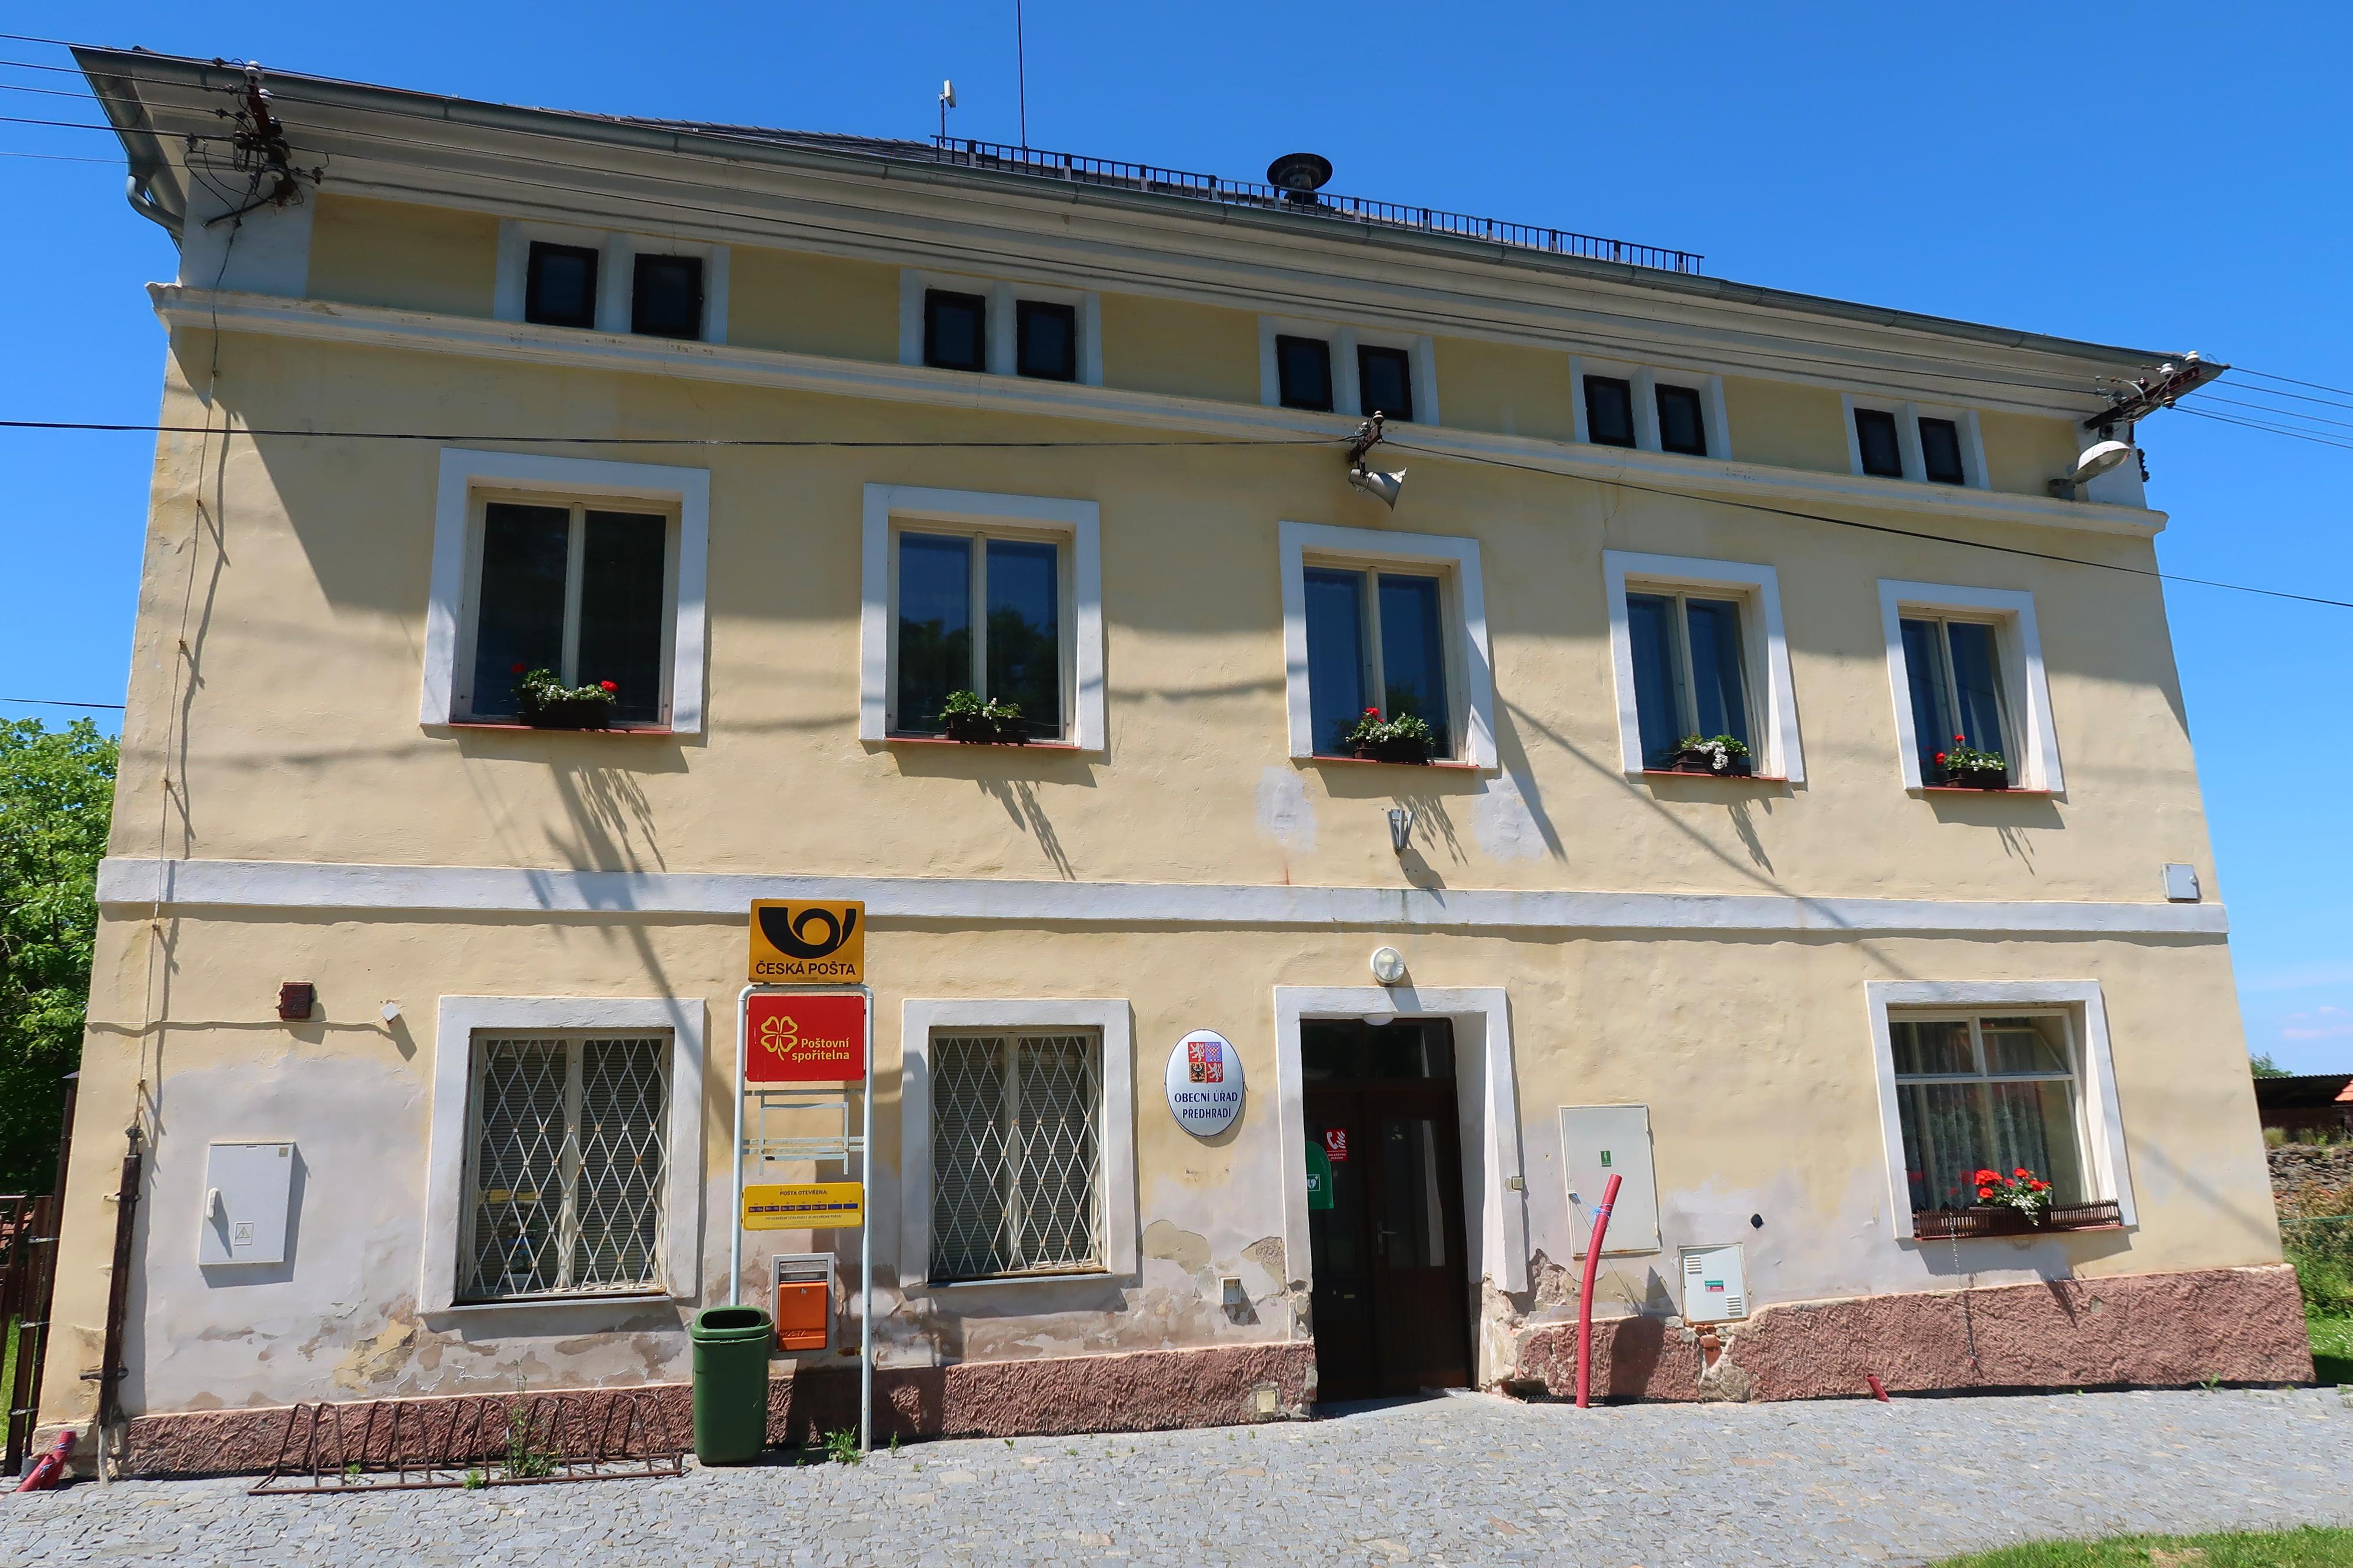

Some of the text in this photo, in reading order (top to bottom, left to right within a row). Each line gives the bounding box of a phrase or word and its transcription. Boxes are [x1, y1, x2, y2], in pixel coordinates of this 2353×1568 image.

[755, 960, 856, 975] ČESKÁ POŠTA
[801, 1037, 849, 1048] Poštovní
[792, 1049, 849, 1063] spořitelna
[1174, 1090, 1238, 1103] OBECNÍ ÚŘAD
[1182, 1106, 1231, 1119] PŘEDHRADÍ
